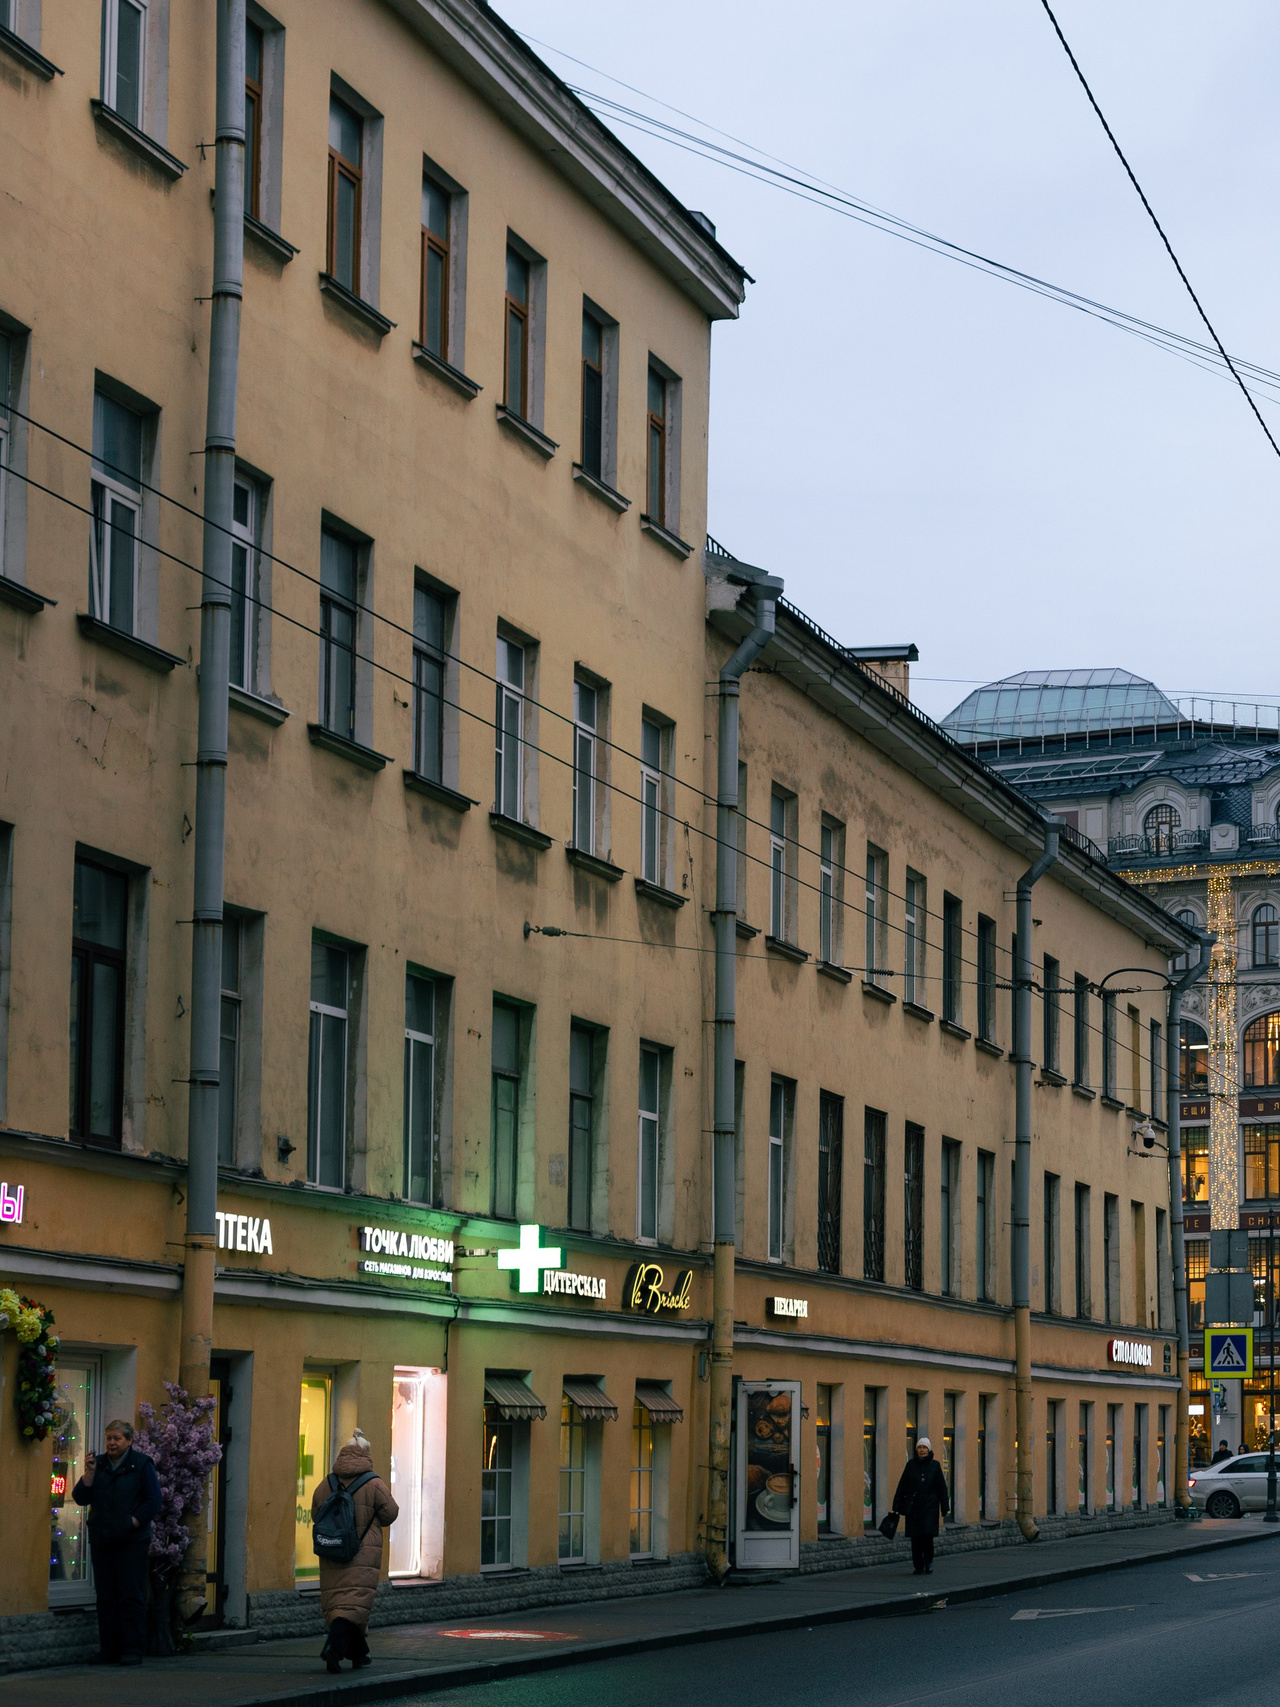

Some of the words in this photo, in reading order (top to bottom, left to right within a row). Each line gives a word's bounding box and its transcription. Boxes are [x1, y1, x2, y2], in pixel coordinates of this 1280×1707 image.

[364, 1226, 408, 1257] ТОЧКА
[409, 1235, 454, 1264] ЛЮБВИ
[364, 1260, 379, 1272] СЕТЬ
[643, 1263, 693, 1313] Brioche
[774, 1296, 808, 1318] ПЕКАРНЯ
